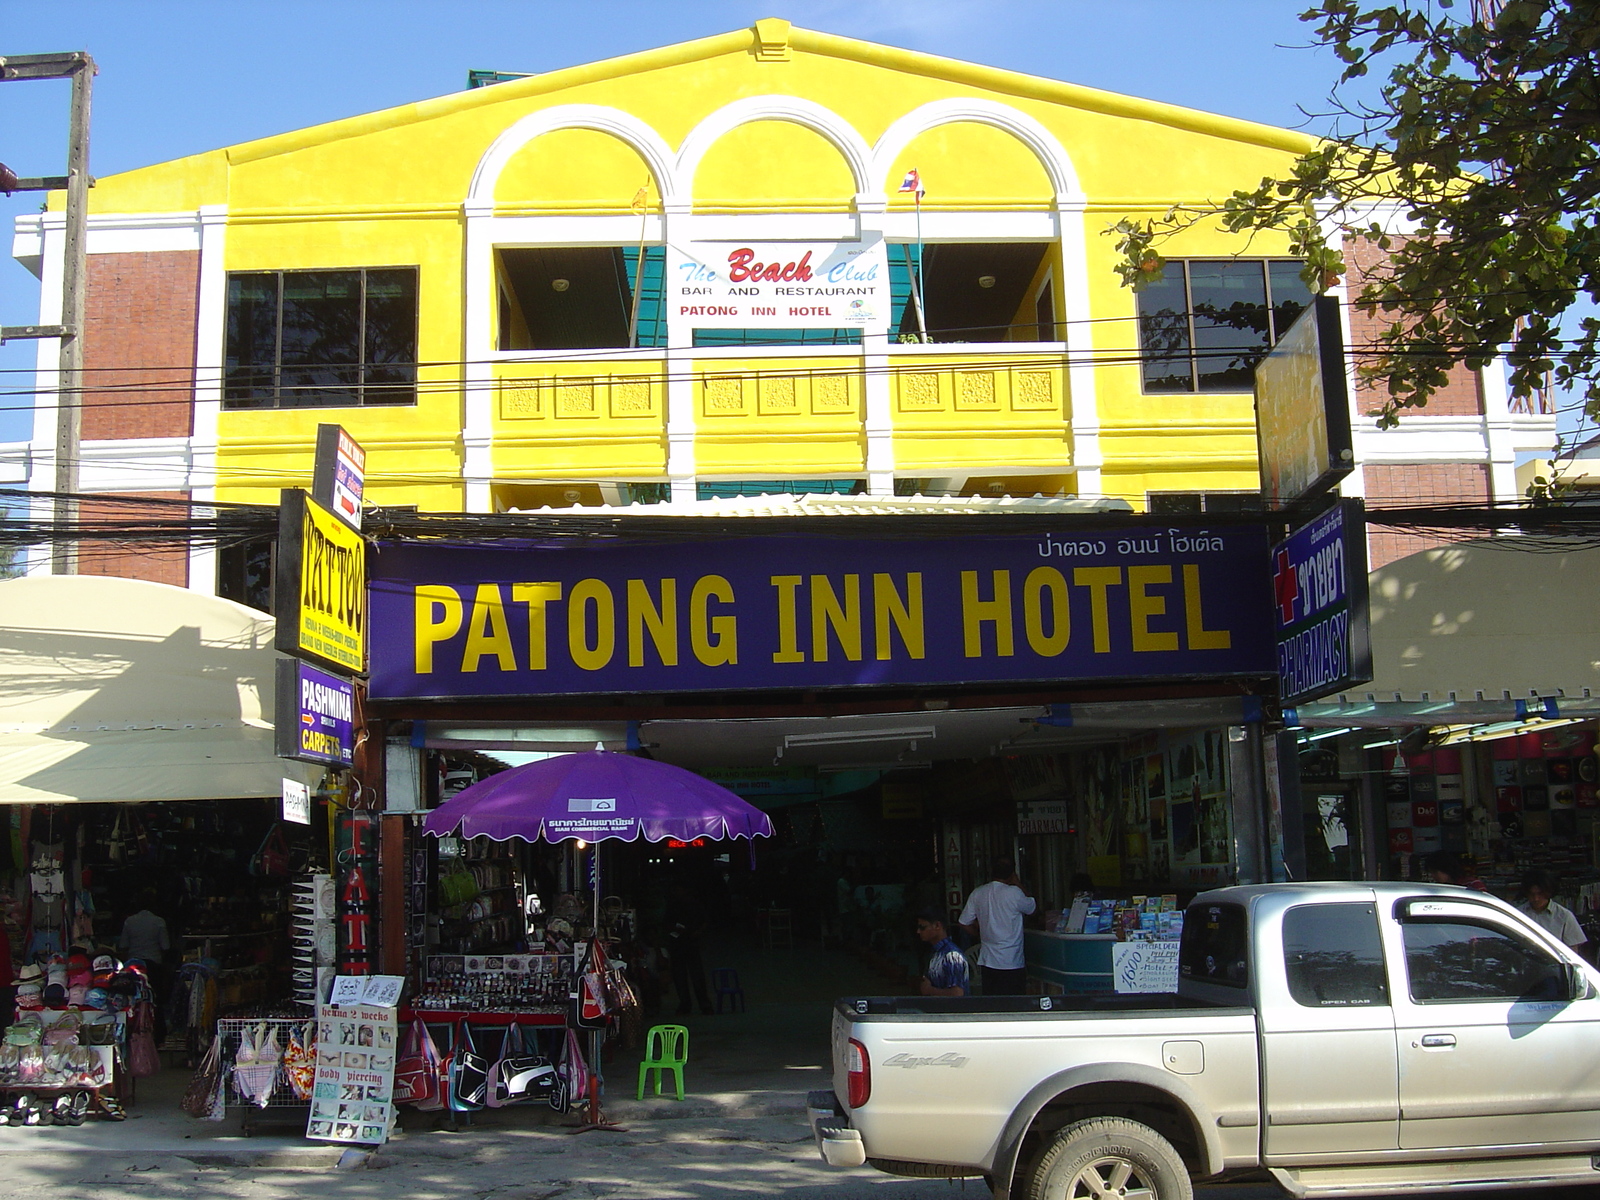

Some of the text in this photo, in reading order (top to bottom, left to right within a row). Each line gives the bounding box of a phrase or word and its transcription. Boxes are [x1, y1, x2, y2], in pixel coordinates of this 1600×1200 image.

[679, 247, 878, 283] The Beach Club
[681, 287, 876, 296] BAR AND RESTAURANT
[680, 306, 832, 316] PATONG INN HOTEL
[1038, 533, 1106, 557] ป่าตอง
[303, 511, 363, 636] TATTOO
[1299, 537, 1345, 616] ขายยา
[415, 564, 1231, 674] PATONG INN HOTEL
[1278, 609, 1347, 700] PHARMACY
[302, 678, 352, 722] PASHMINA
[1417, 806, 1436, 815] D&G
[1020, 819, 1065, 833] PHARMACY
[321, 1007, 388, 1021] henna 2 weeks
[882, 1052, 970, 1069] 4x4
[319, 1068, 382, 1085] body piercing
